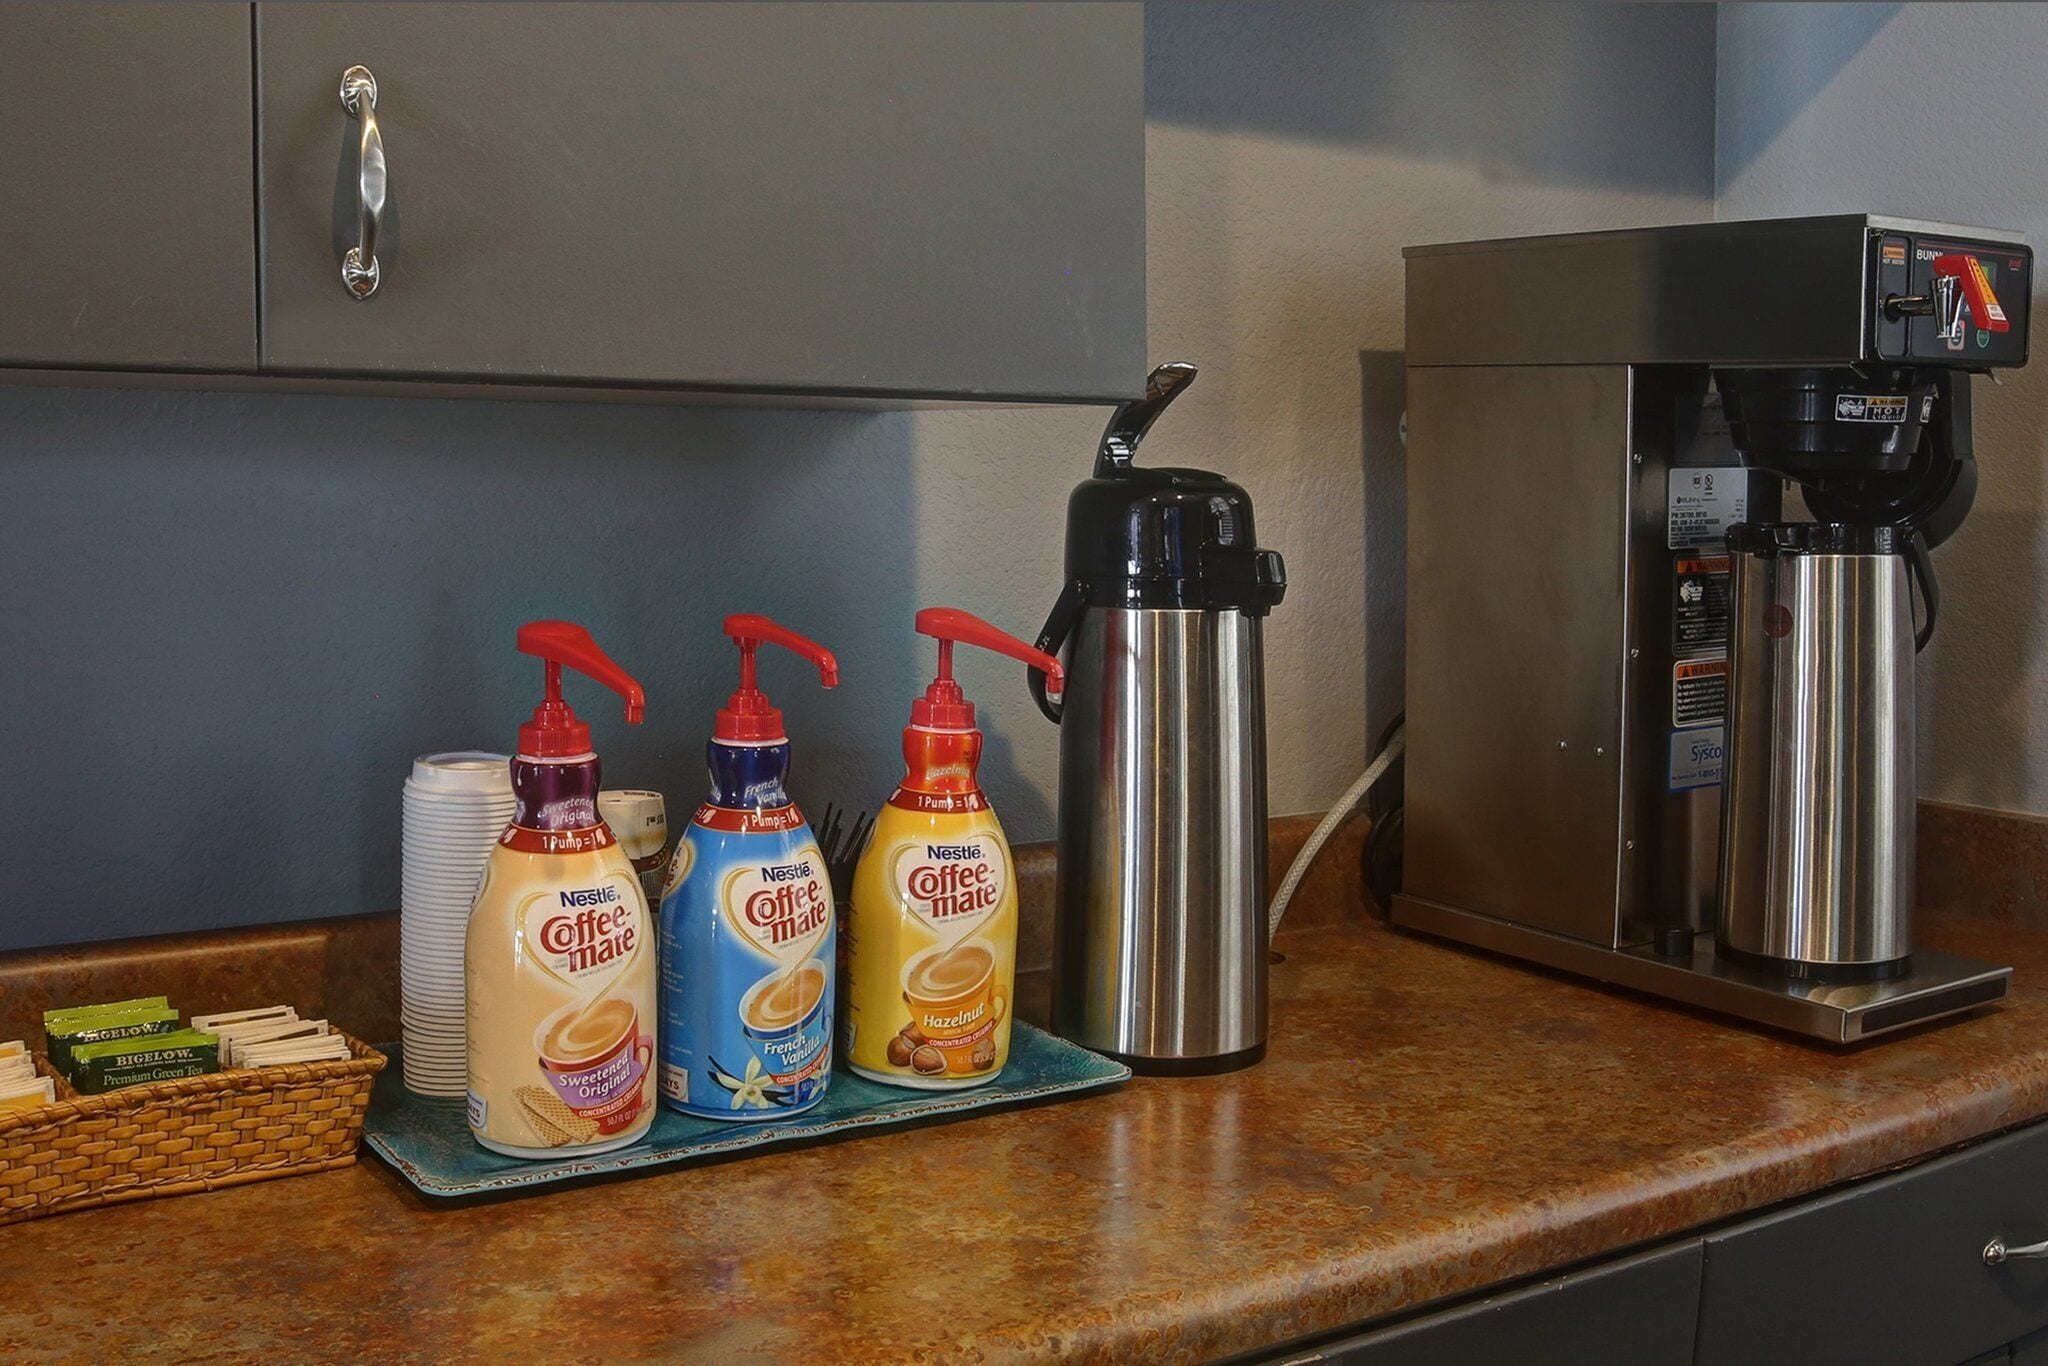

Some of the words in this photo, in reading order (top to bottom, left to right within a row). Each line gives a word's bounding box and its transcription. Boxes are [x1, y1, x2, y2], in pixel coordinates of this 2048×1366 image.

[1691, 745, 1722, 764] Sysco
[744, 776, 778, 799] French
[925, 795, 954, 812] Pump
[551, 810, 594, 827] Original
[550, 835, 582, 851] Pump
[927, 845, 981, 860] Nestlé
[761, 861, 811, 882] Nestlé
[560, 885, 617, 907] Nestlé
[931, 884, 997, 918] mate
[770, 901, 826, 943] mate
[568, 927, 635, 973] mate
[923, 1002, 985, 1028] Hazelnut
[764, 1033, 806, 1055] French
[782, 1035, 821, 1066] Vanilla
[115, 1049, 192, 1067] BIGELOW
[559, 1048, 629, 1087] Sweetened
[103, 1070, 151, 1086] Premium
[152, 1066, 184, 1081] Green
[184, 1065, 204, 1076] Tea
[579, 1063, 631, 1098] Original
[579, 1099, 623, 1117] CONCENTRATED
